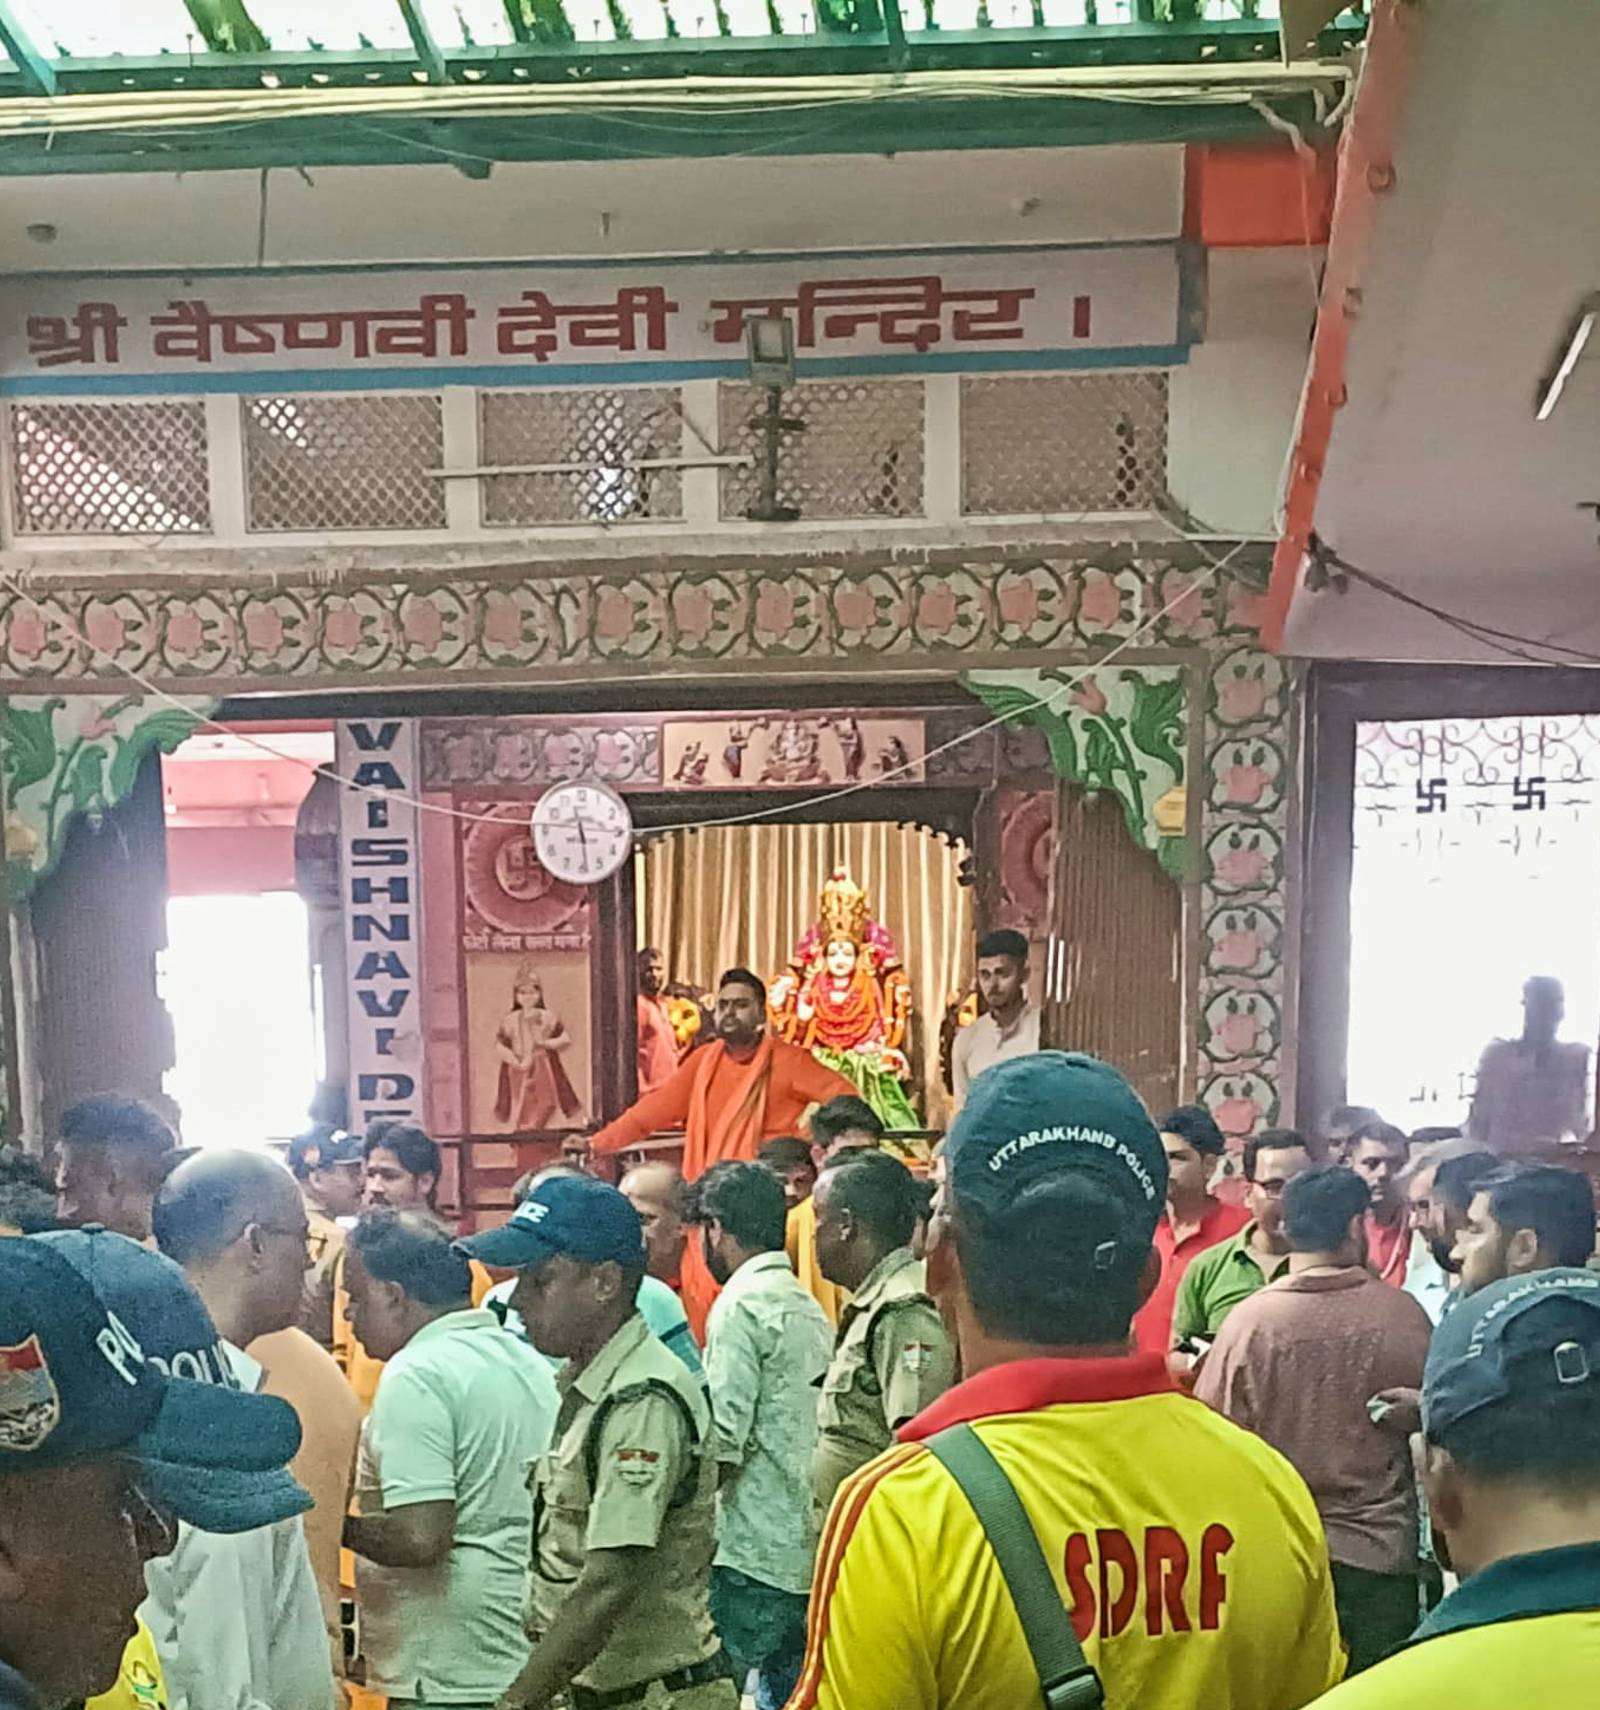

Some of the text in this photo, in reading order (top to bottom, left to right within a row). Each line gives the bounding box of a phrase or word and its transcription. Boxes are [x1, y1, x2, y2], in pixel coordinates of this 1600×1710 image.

[26, 302, 128, 366] श्री
[150, 294, 476, 363] वैष्णवी
[498, 286, 679, 362] देवी
[988, 1125, 1156, 1201] UTTARAKHAND POLICE
[1064, 1522, 1235, 1644] SDRF
